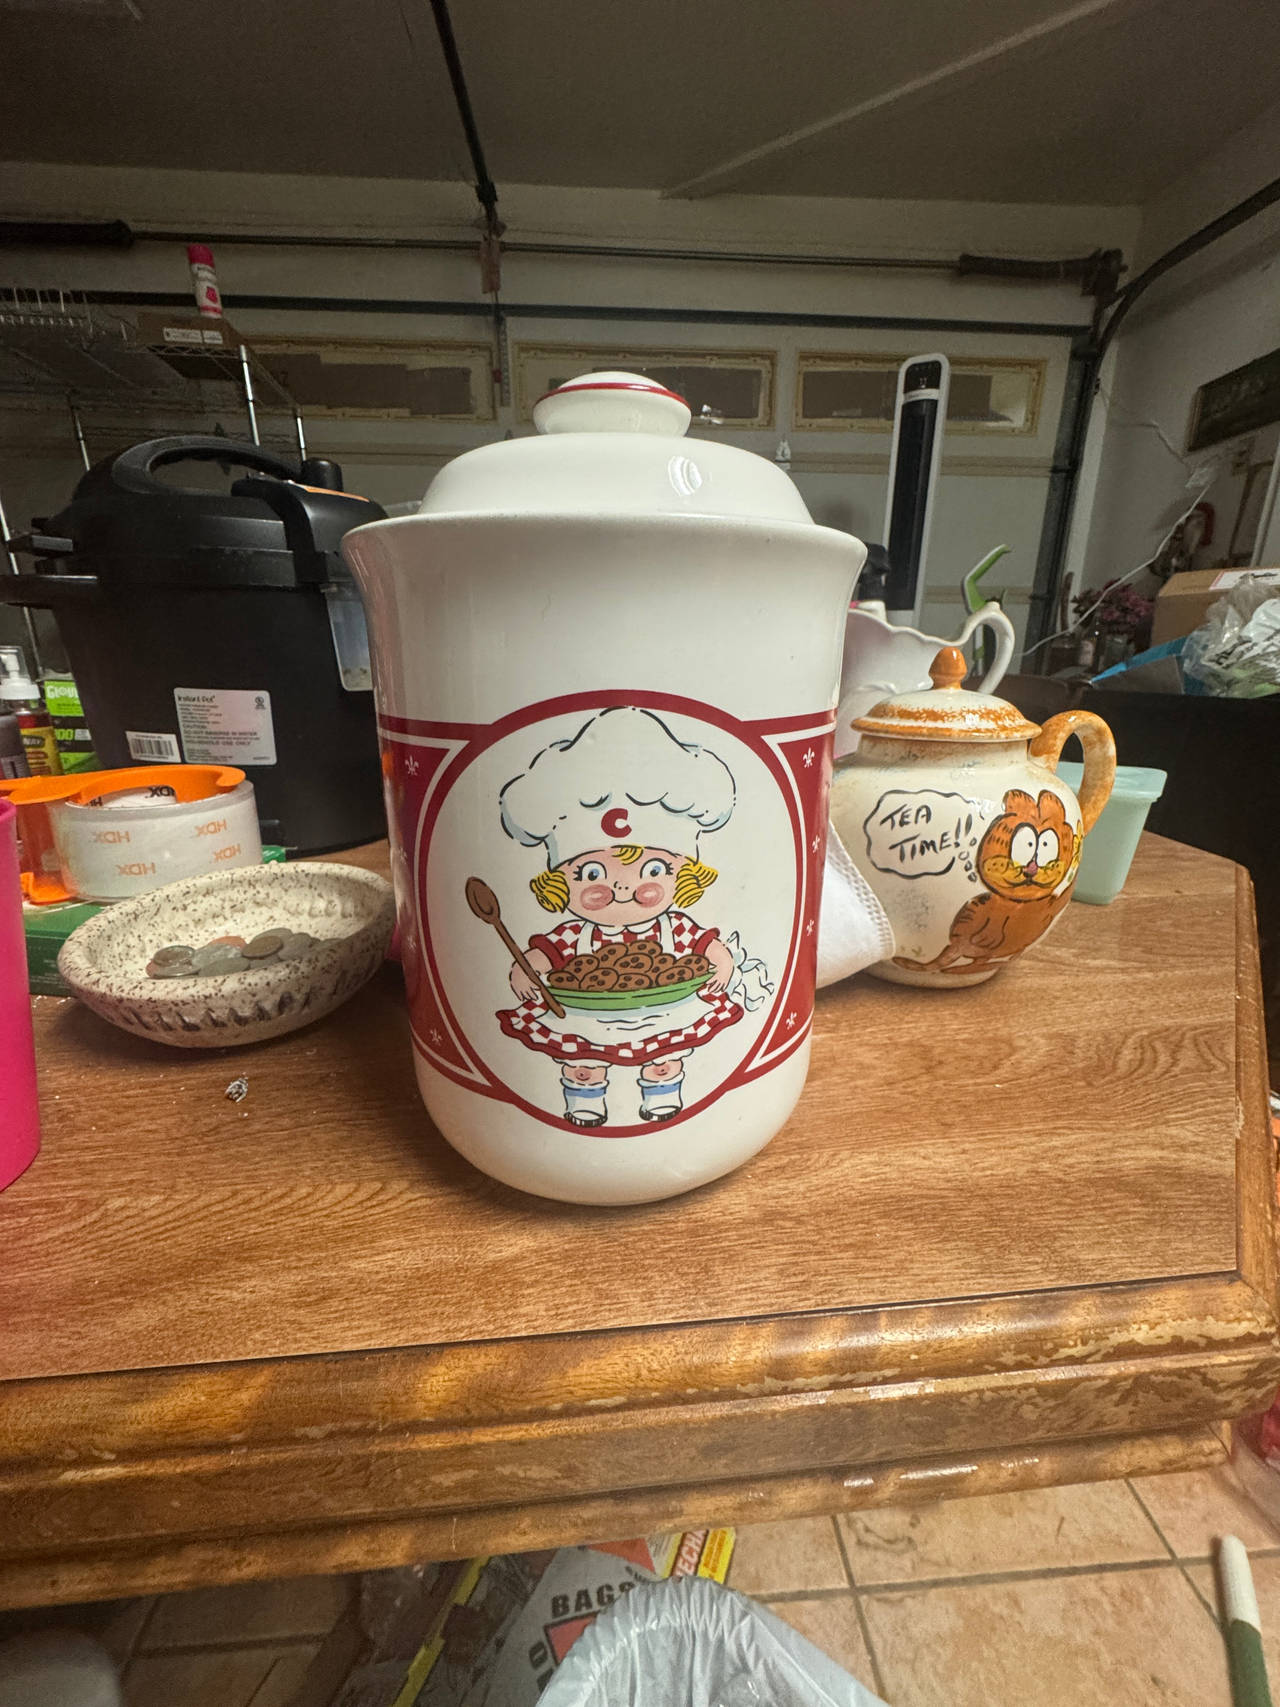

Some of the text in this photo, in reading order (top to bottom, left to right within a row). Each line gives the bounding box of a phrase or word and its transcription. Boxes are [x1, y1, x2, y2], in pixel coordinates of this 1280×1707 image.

[600, 807, 633, 838] C
[880, 804, 932, 831] TEA
[888, 813, 977, 863] TIME!!
